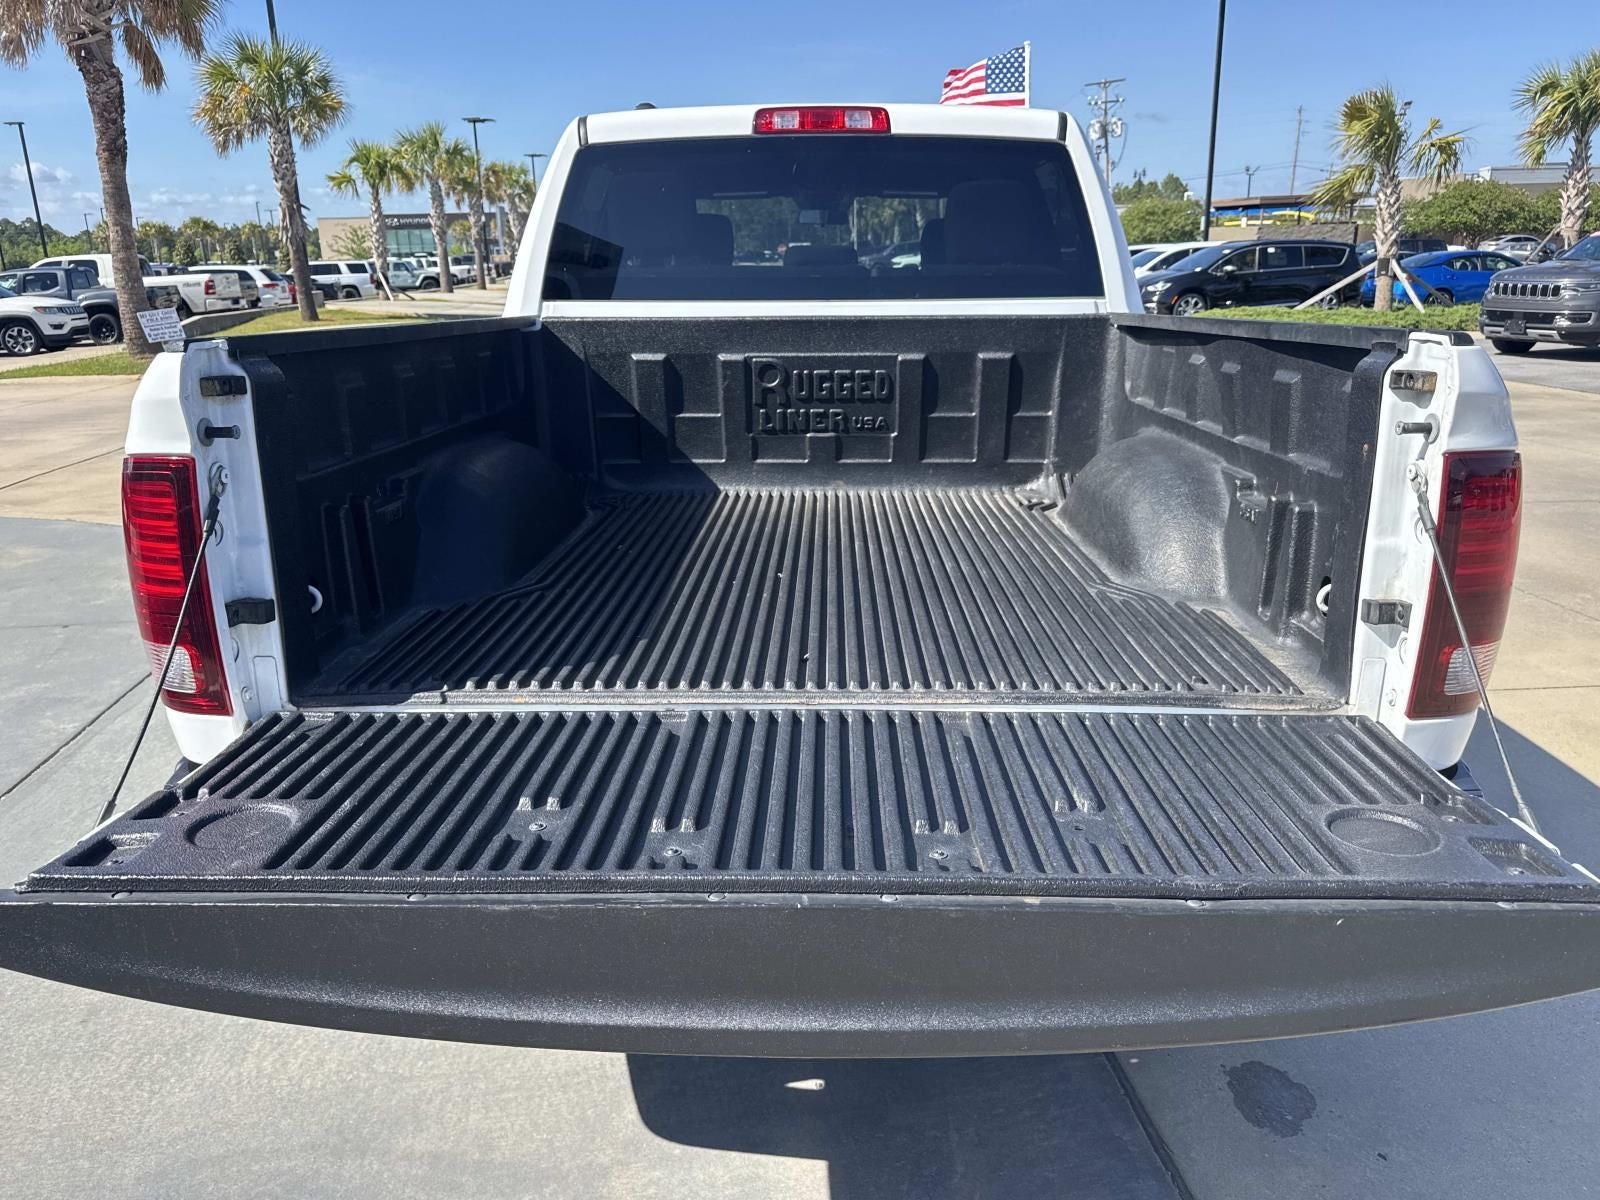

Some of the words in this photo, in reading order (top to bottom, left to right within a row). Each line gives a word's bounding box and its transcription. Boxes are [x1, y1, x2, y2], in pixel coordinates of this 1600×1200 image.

[752, 358, 893, 406] RUGGED
[759, 409, 847, 433] LINER
[851, 416, 888, 430] USA
